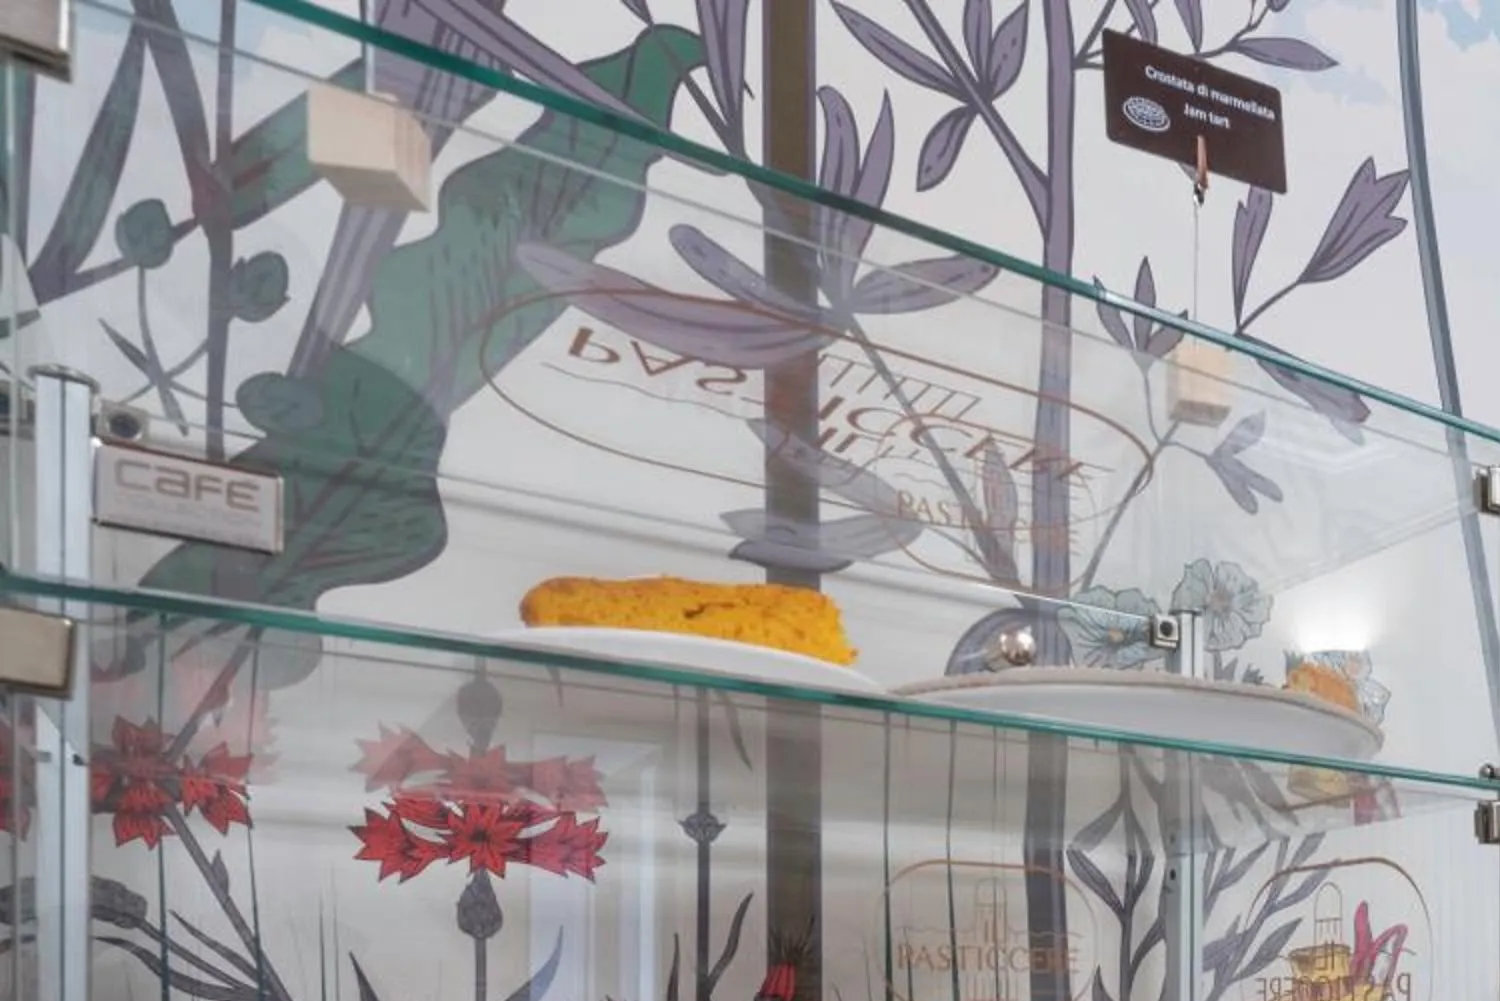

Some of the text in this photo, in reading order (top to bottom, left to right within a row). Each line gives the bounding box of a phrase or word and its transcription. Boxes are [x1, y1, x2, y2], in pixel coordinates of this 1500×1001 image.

[1145, 64, 1276, 121] Crostata di marmellata
[1183, 102, 1231, 129] Jam tart
